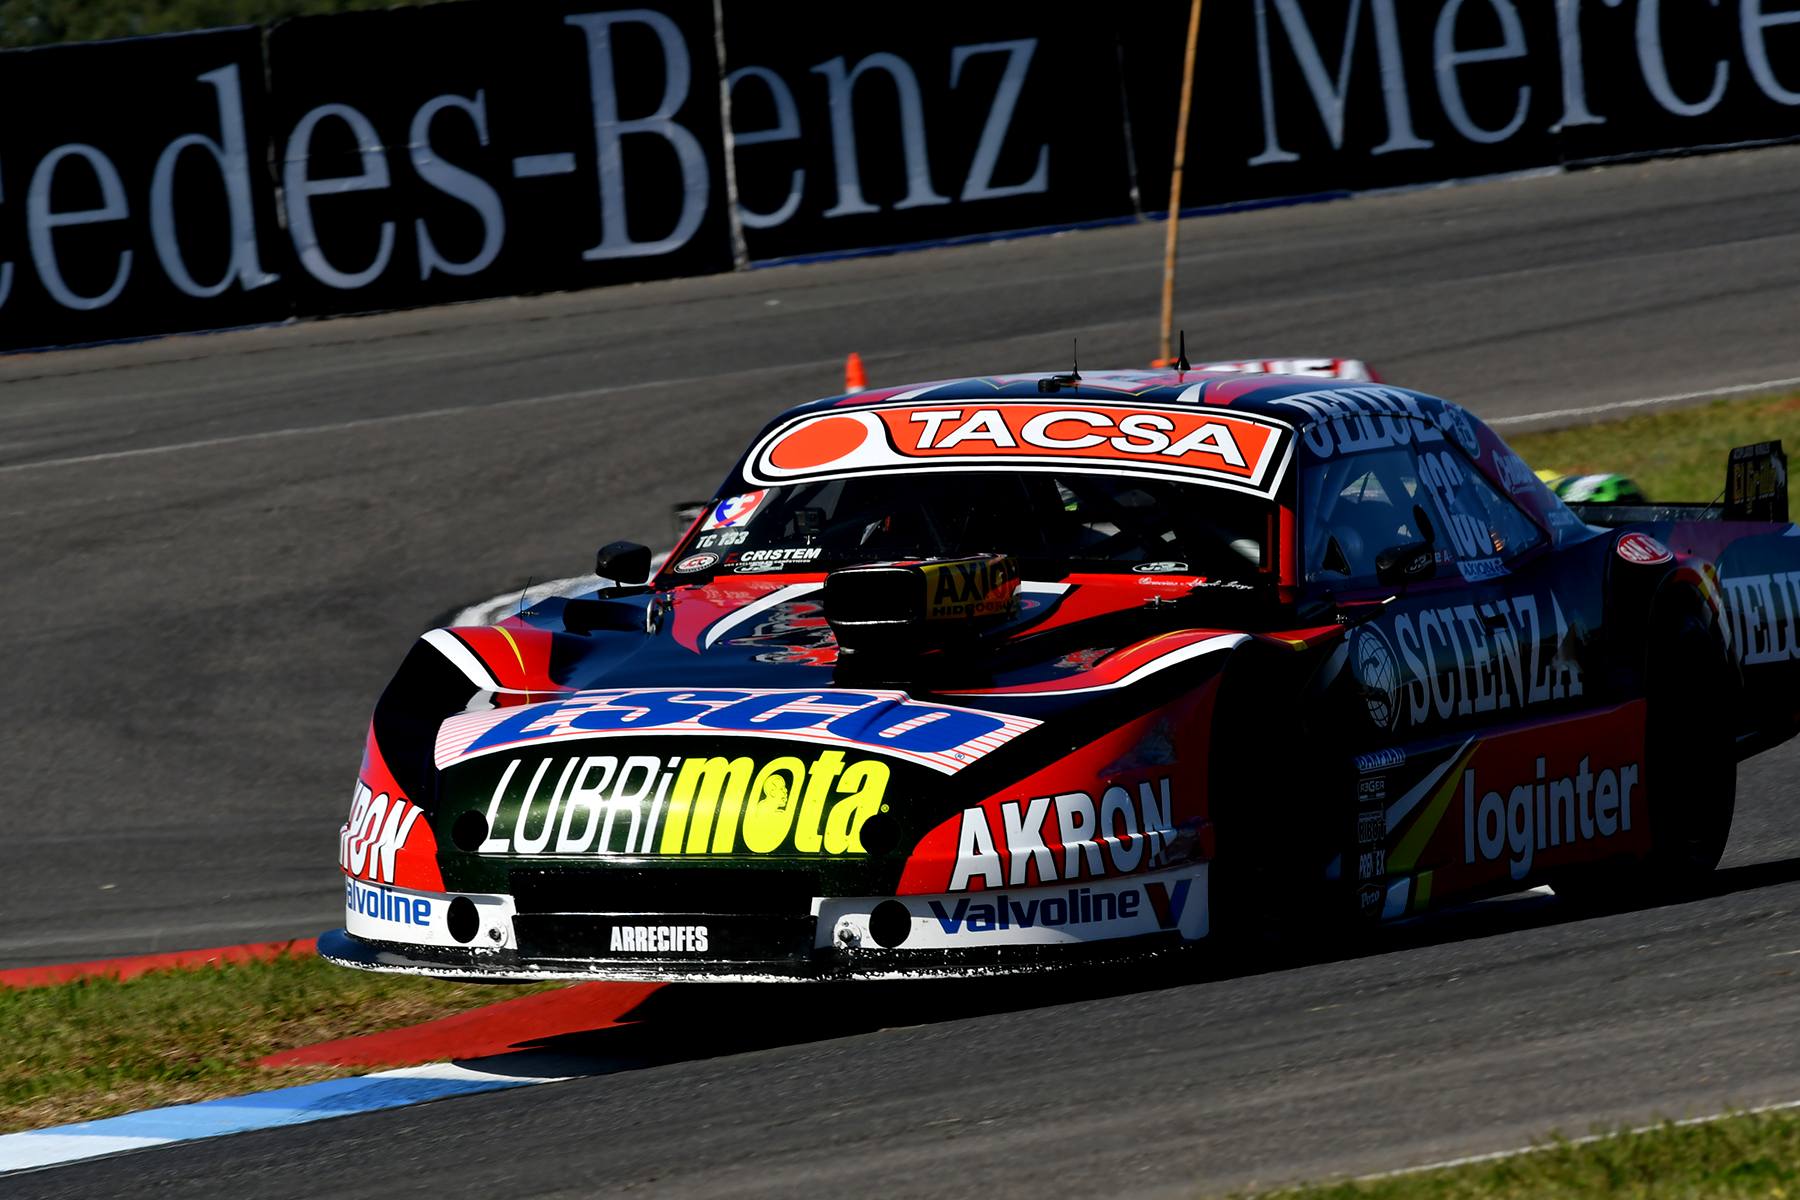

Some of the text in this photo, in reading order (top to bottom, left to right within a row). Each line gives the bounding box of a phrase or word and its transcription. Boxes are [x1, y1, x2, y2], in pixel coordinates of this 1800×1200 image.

[0, 9, 1049, 310] edes-Benz
[909, 409, 1246, 468] TACSA
[696, 531, 749, 549] TC 133
[741, 548, 822, 562] CRISTEM
[1394, 586, 1584, 726] SCIENZA
[340, 778, 424, 884] RON
[949, 778, 1177, 891] AKRON
[1465, 755, 1638, 880] loginter
[610, 926, 708, 951] ARRECIFES
[928, 888, 1139, 934] Valvoline
